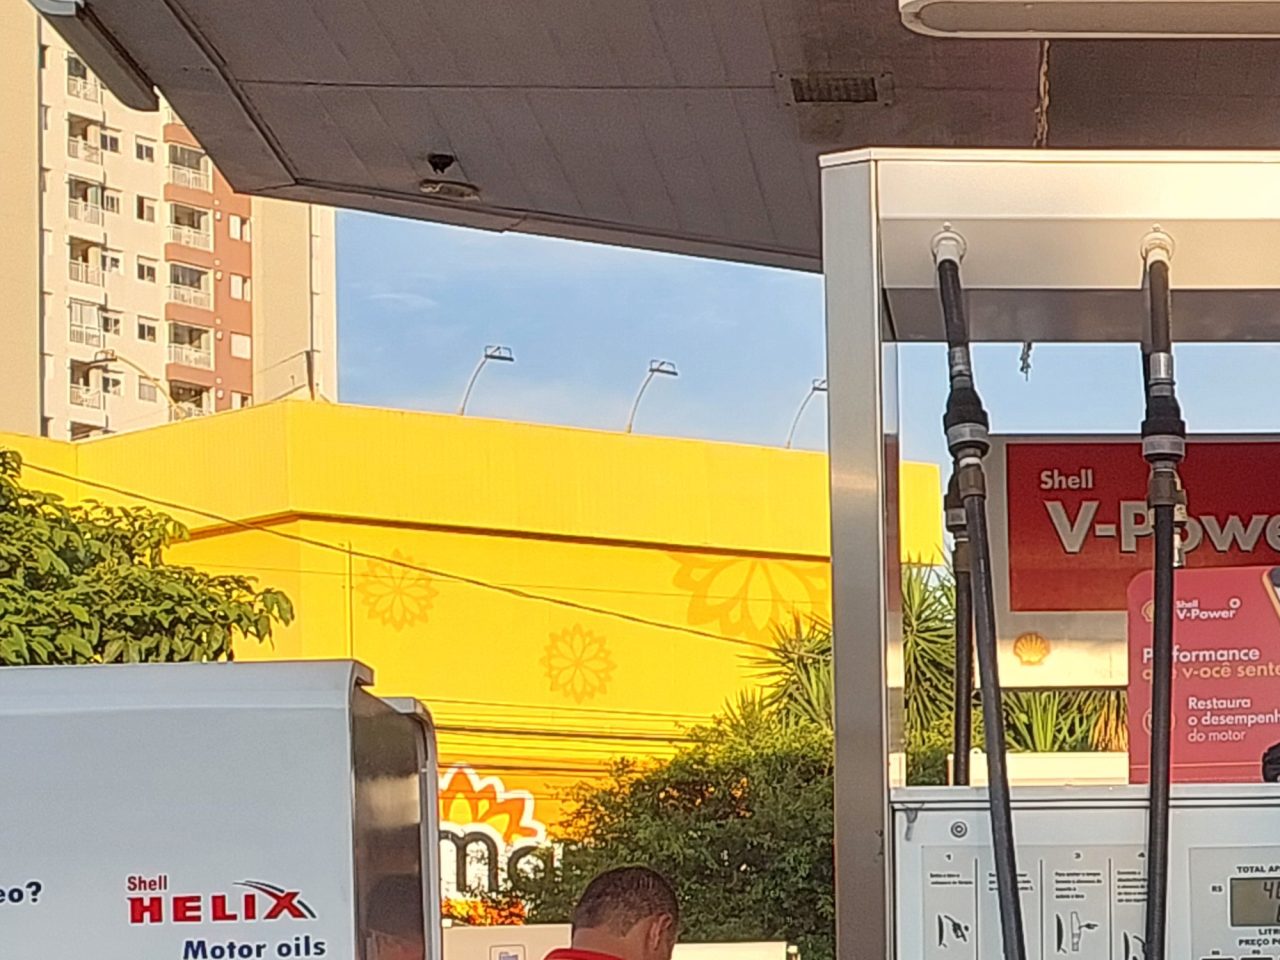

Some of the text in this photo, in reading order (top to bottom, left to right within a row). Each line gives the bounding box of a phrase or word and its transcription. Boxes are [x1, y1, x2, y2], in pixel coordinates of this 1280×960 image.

[1040, 469, 1093, 489] Shell
[1176, 600, 1199, 608] Shell
[1176, 610, 1236, 620] V-Power
[1143, 645, 1260, 663] Pformance
[1188, 697, 1251, 709] Restaura
[1188, 716, 1198, 725] o
[1188, 728, 1246, 742] do motor
[127, 876, 167, 891] Shell
[128, 884, 312, 924] HELIX
[183, 935, 326, 960] Motor oils
[1238, 938, 1270, 947] PREÇO
